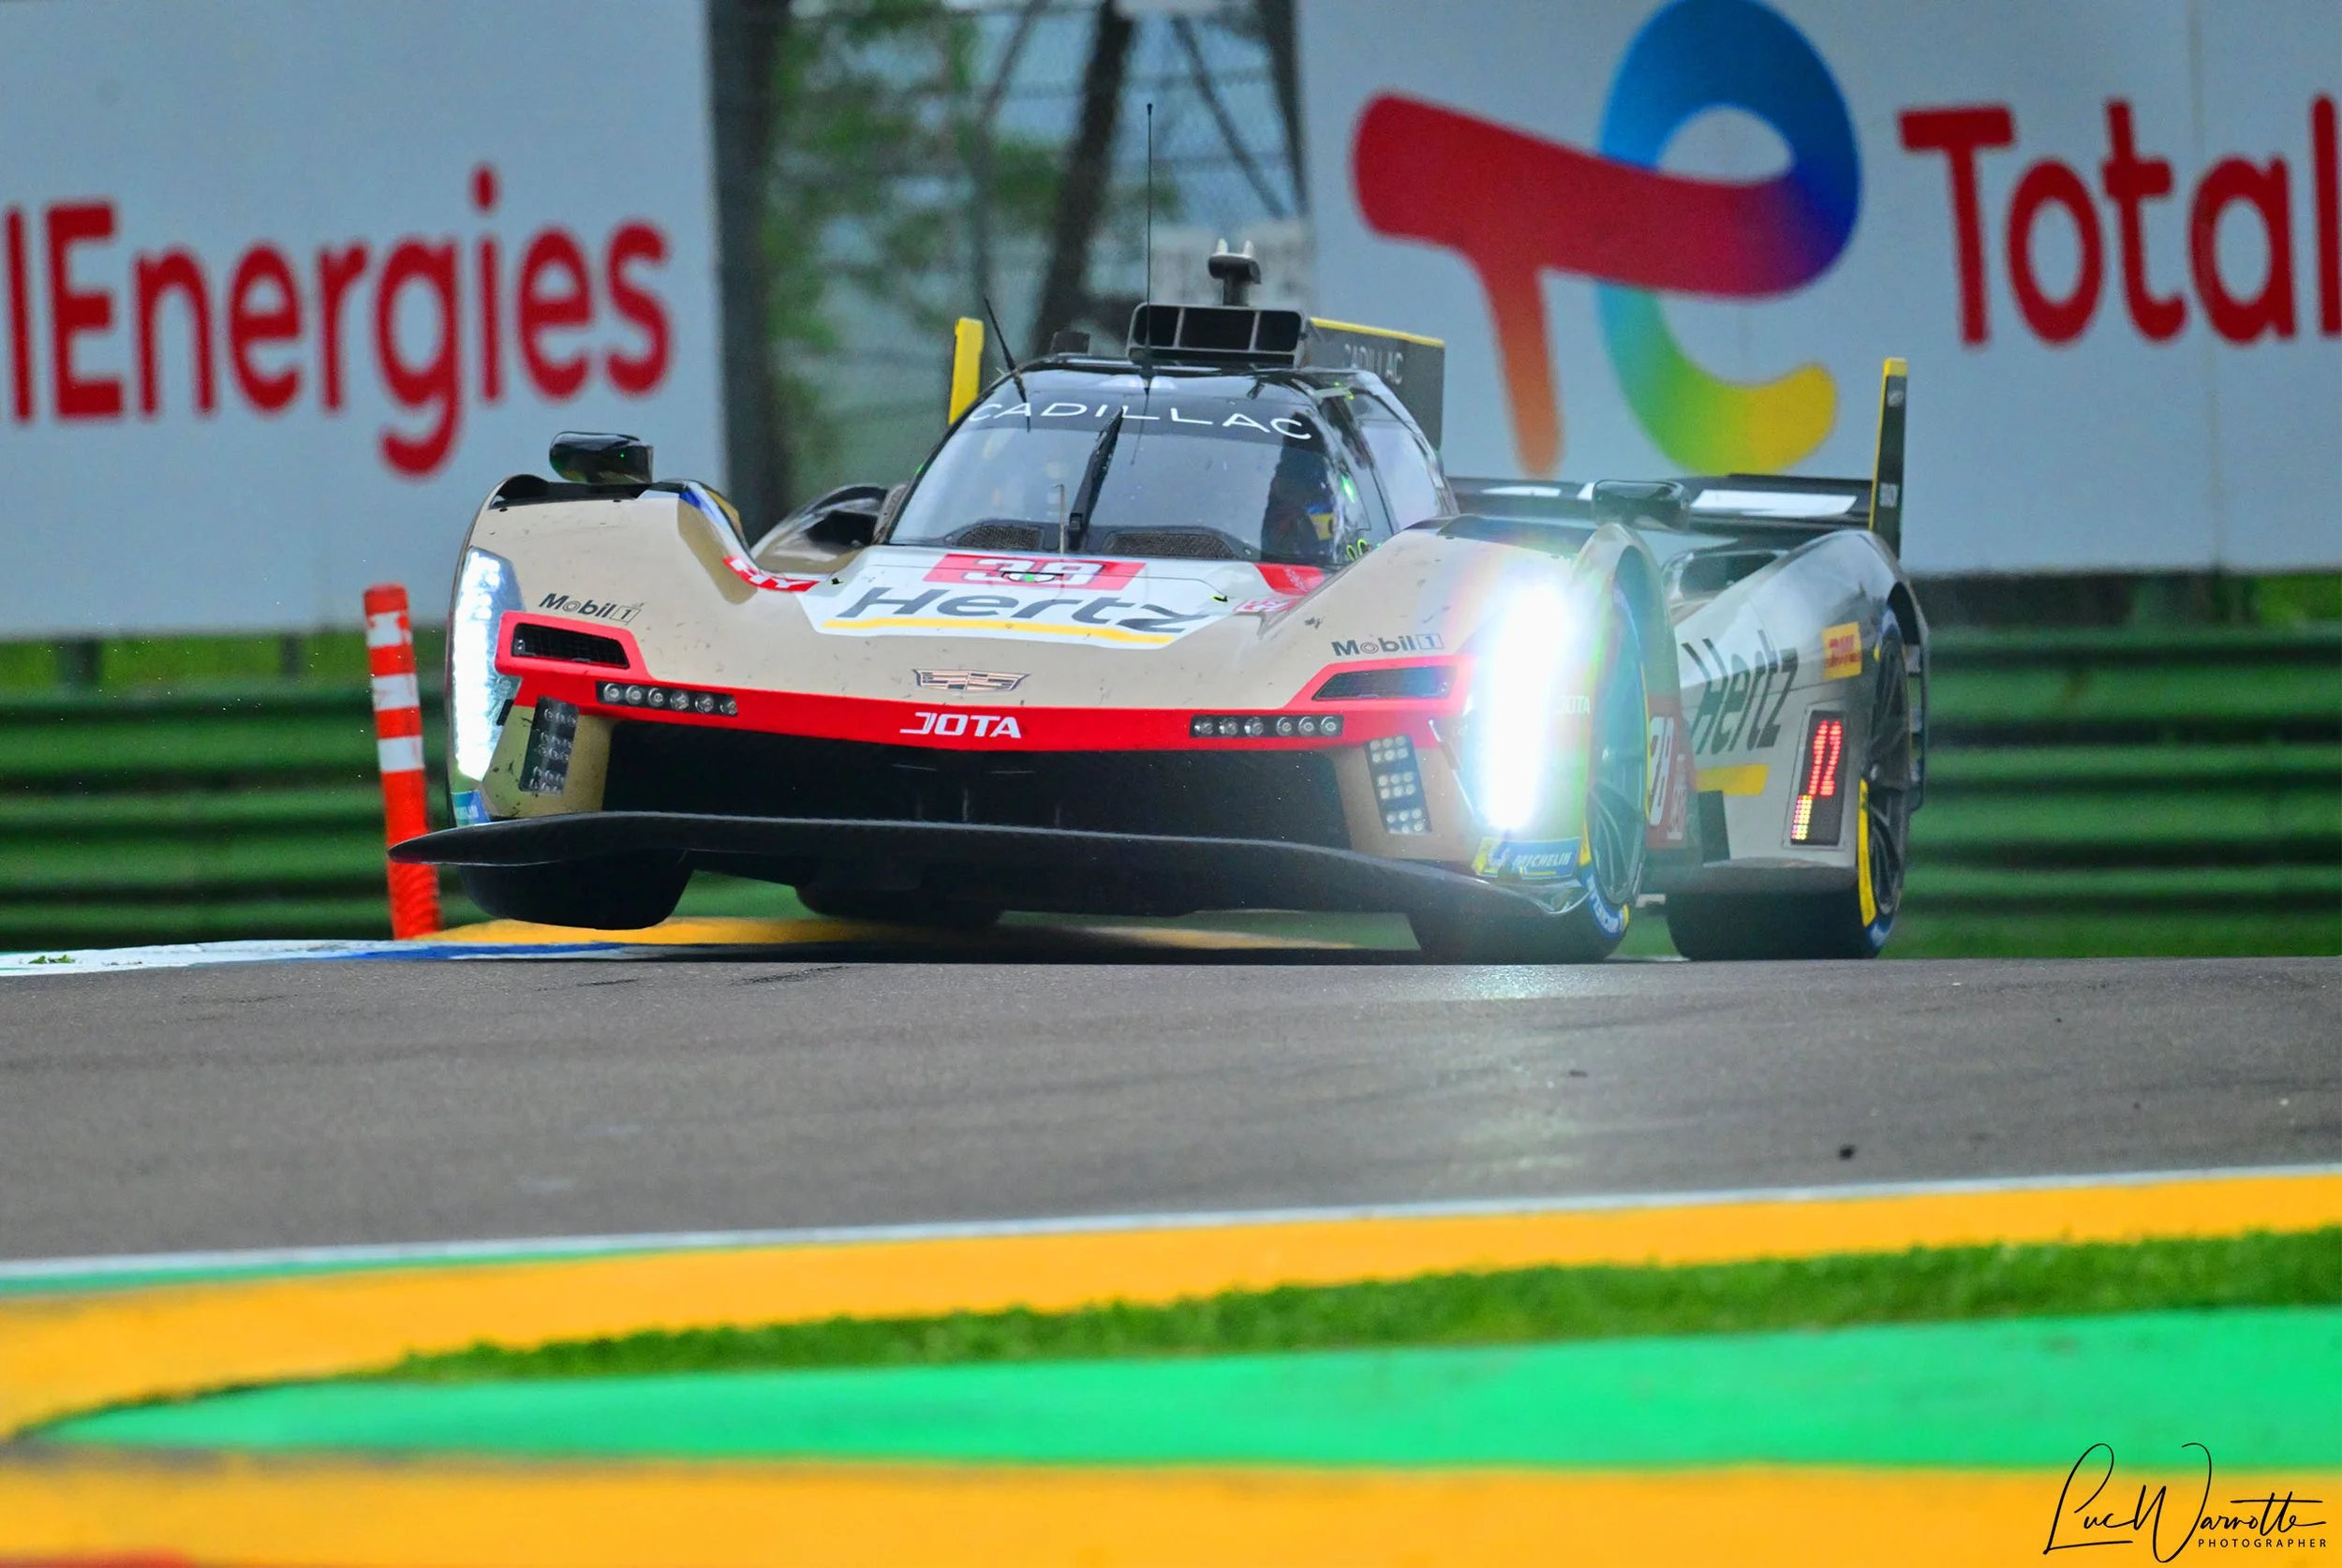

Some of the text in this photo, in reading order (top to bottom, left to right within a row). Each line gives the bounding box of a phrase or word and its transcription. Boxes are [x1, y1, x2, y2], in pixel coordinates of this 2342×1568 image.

[1896, 92, 2342, 350] Total
[969, 402, 1312, 440] CADILLAC
[836, 586, 1211, 633] Hertz
[1682, 629, 1799, 755] Hertz
[899, 712, 1022, 738] JOTA
[1512, 851, 1572, 867] MICHELIN
